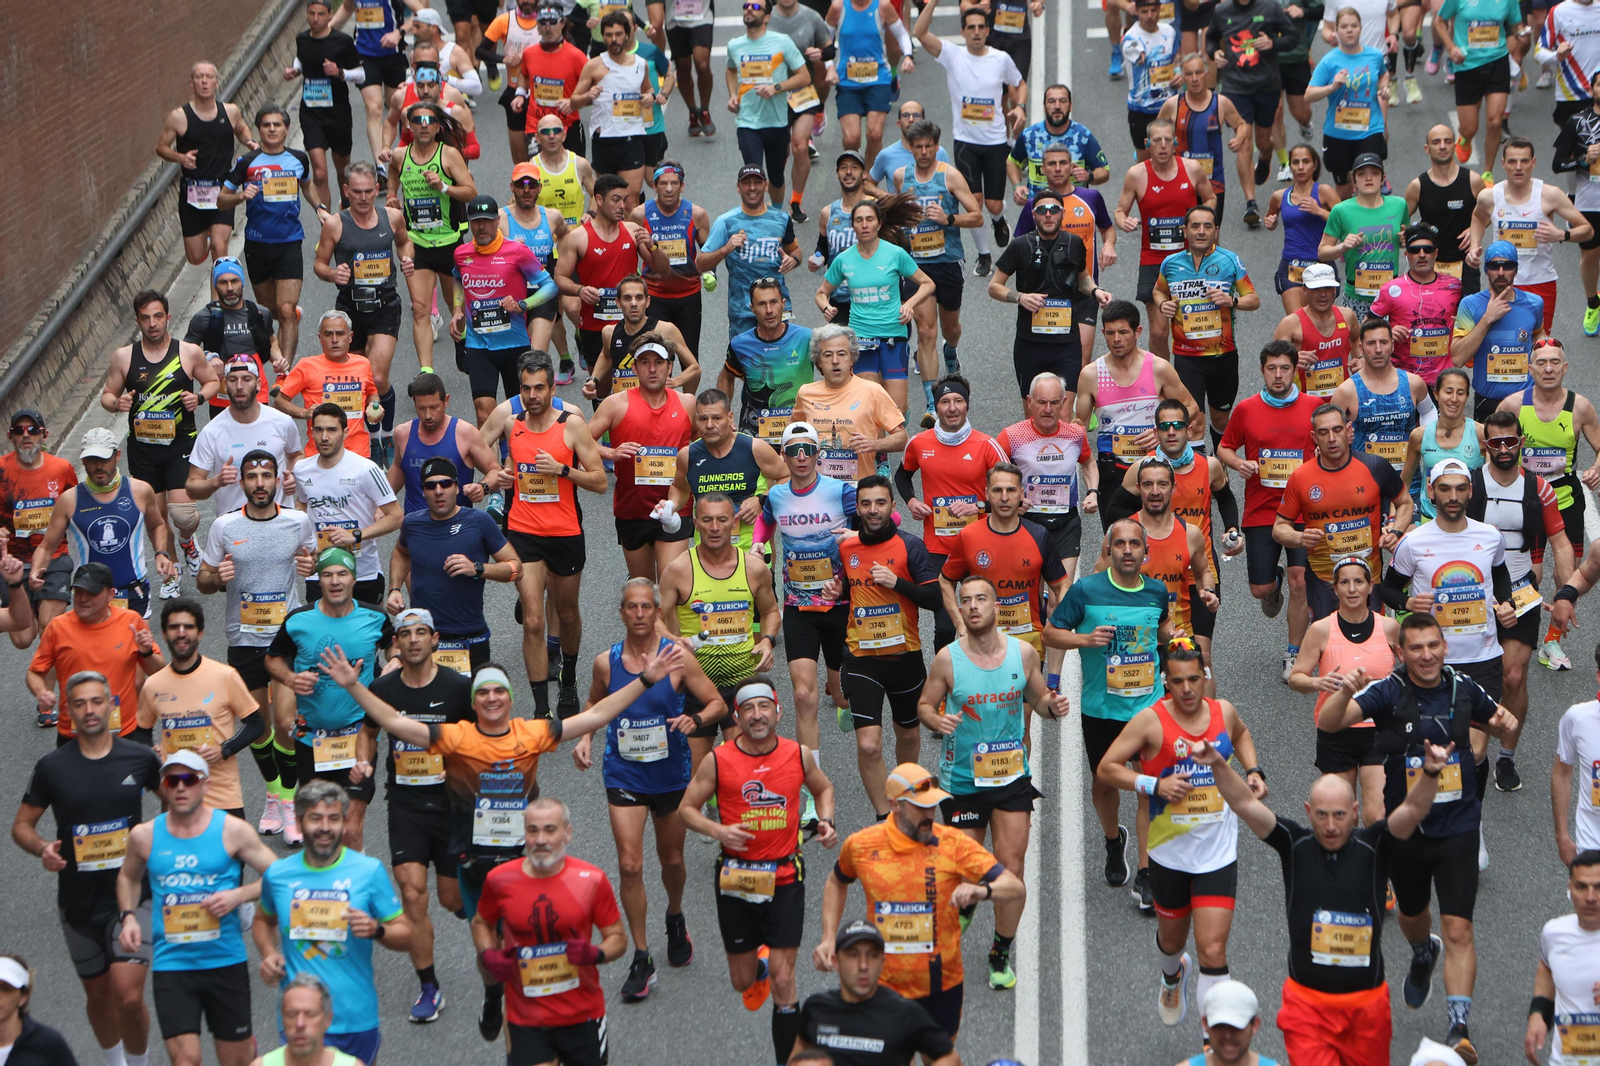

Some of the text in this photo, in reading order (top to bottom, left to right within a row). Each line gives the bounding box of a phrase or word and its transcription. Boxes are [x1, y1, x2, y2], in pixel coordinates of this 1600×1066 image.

[919, 225, 940, 233] ZURICH
[462, 273, 505, 289] Cuevas
[1183, 279, 1205, 289] TRAIL
[1178, 289, 1199, 298] TEAM
[1319, 338, 1342, 350] DATO
[1317, 360, 1340, 369] ZURICH
[1318, 373, 1332, 381] 4975
[699, 473, 745, 482] RUNNEIROS
[698, 483, 747, 493] OURENSANS
[1332, 506, 1376, 518] CAMAS
[788, 513, 832, 526] KONA
[1340, 520, 1365, 529] ZURICH
[1342, 535, 1358, 543] 5396
[998, 579, 1035, 589] CAMAS
[1452, 592, 1480, 600] ZURICH
[869, 607, 894, 615] ZURICH
[870, 621, 886, 629] 3745
[1124, 654, 1149, 663] ZURICH
[967, 686, 1021, 704] atracón
[177, 718, 206, 727] ZURICH
[632, 719, 659, 727] ZURICH
[633, 734, 650, 742] 9407
[479, 772, 524, 780] COMERCIAL
[493, 801, 523, 809] ZURICH
[961, 812, 979, 820] tribe
[90, 822, 122, 833] ZURICH
[174, 855, 198, 868] 50
[157, 874, 218, 886] TODAY
[894, 921, 914, 930] 4723
